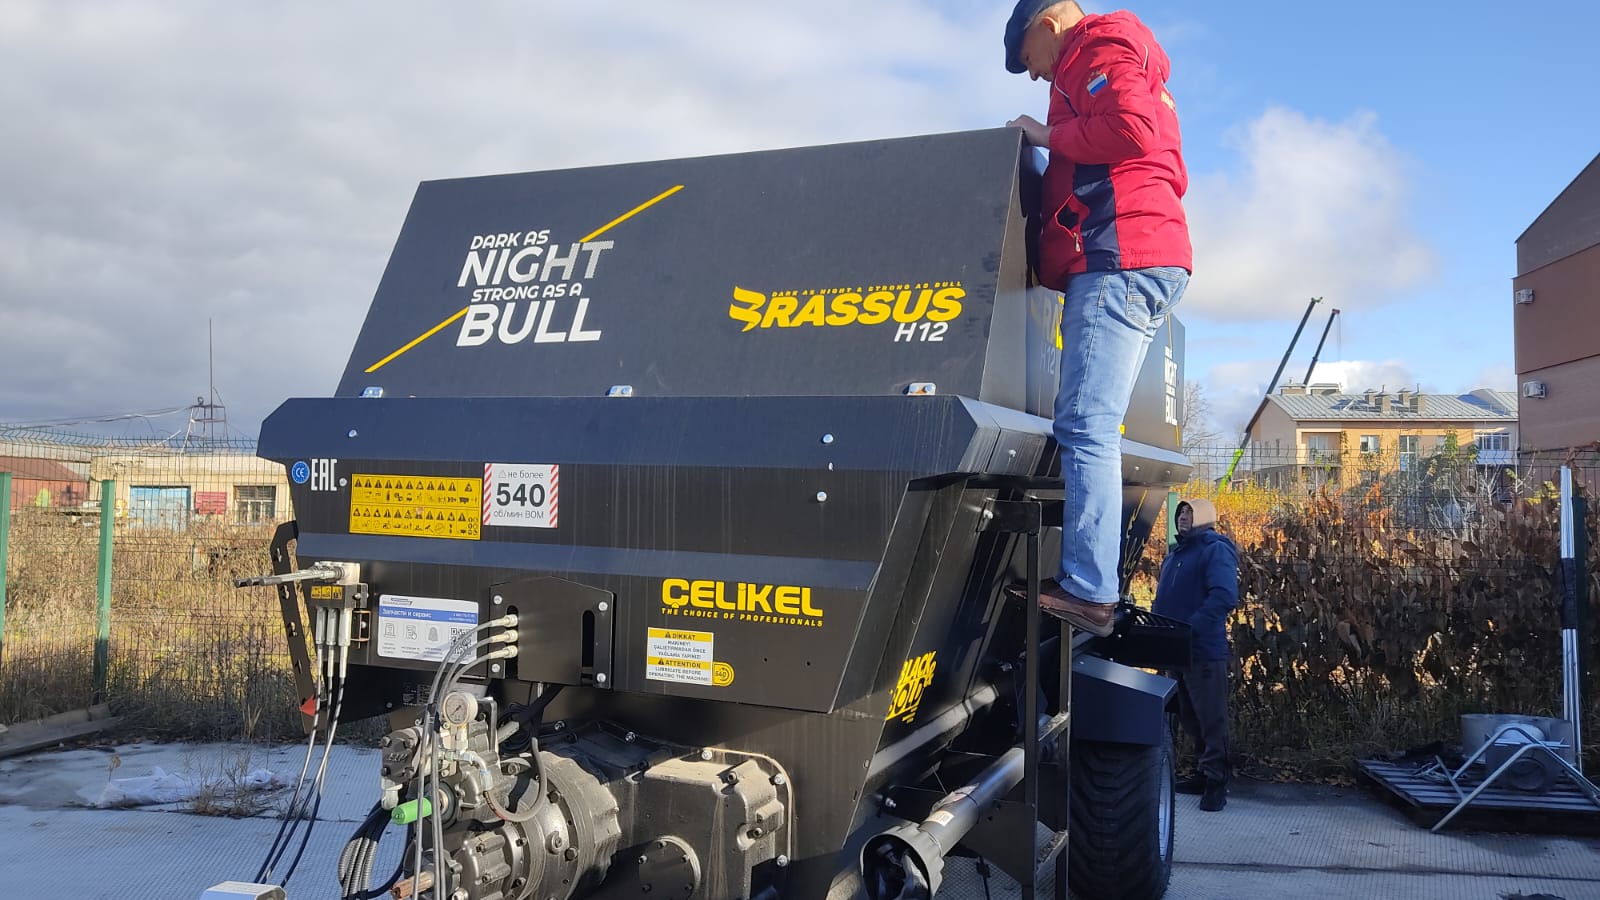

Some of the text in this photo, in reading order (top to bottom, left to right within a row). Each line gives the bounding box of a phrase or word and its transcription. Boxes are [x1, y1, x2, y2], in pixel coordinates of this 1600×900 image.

[470, 230, 550, 250] DARK AS
[457, 240, 614, 287] NIGHT
[471, 282, 582, 302] STRONG AS A
[820, 287, 852, 295] NIGHT
[868, 284, 910, 292] STRONG
[729, 286, 966, 332] BRASSUS
[456, 298, 602, 346] BULL
[508, 470, 544, 479] не более
[496, 482, 546, 507] 540
[494, 510, 544, 519] об/мин ВОМ
[661, 607, 823, 627] THE CHOICE OF PROFESSIONALS
[666, 660, 701, 668] ATTENTION
